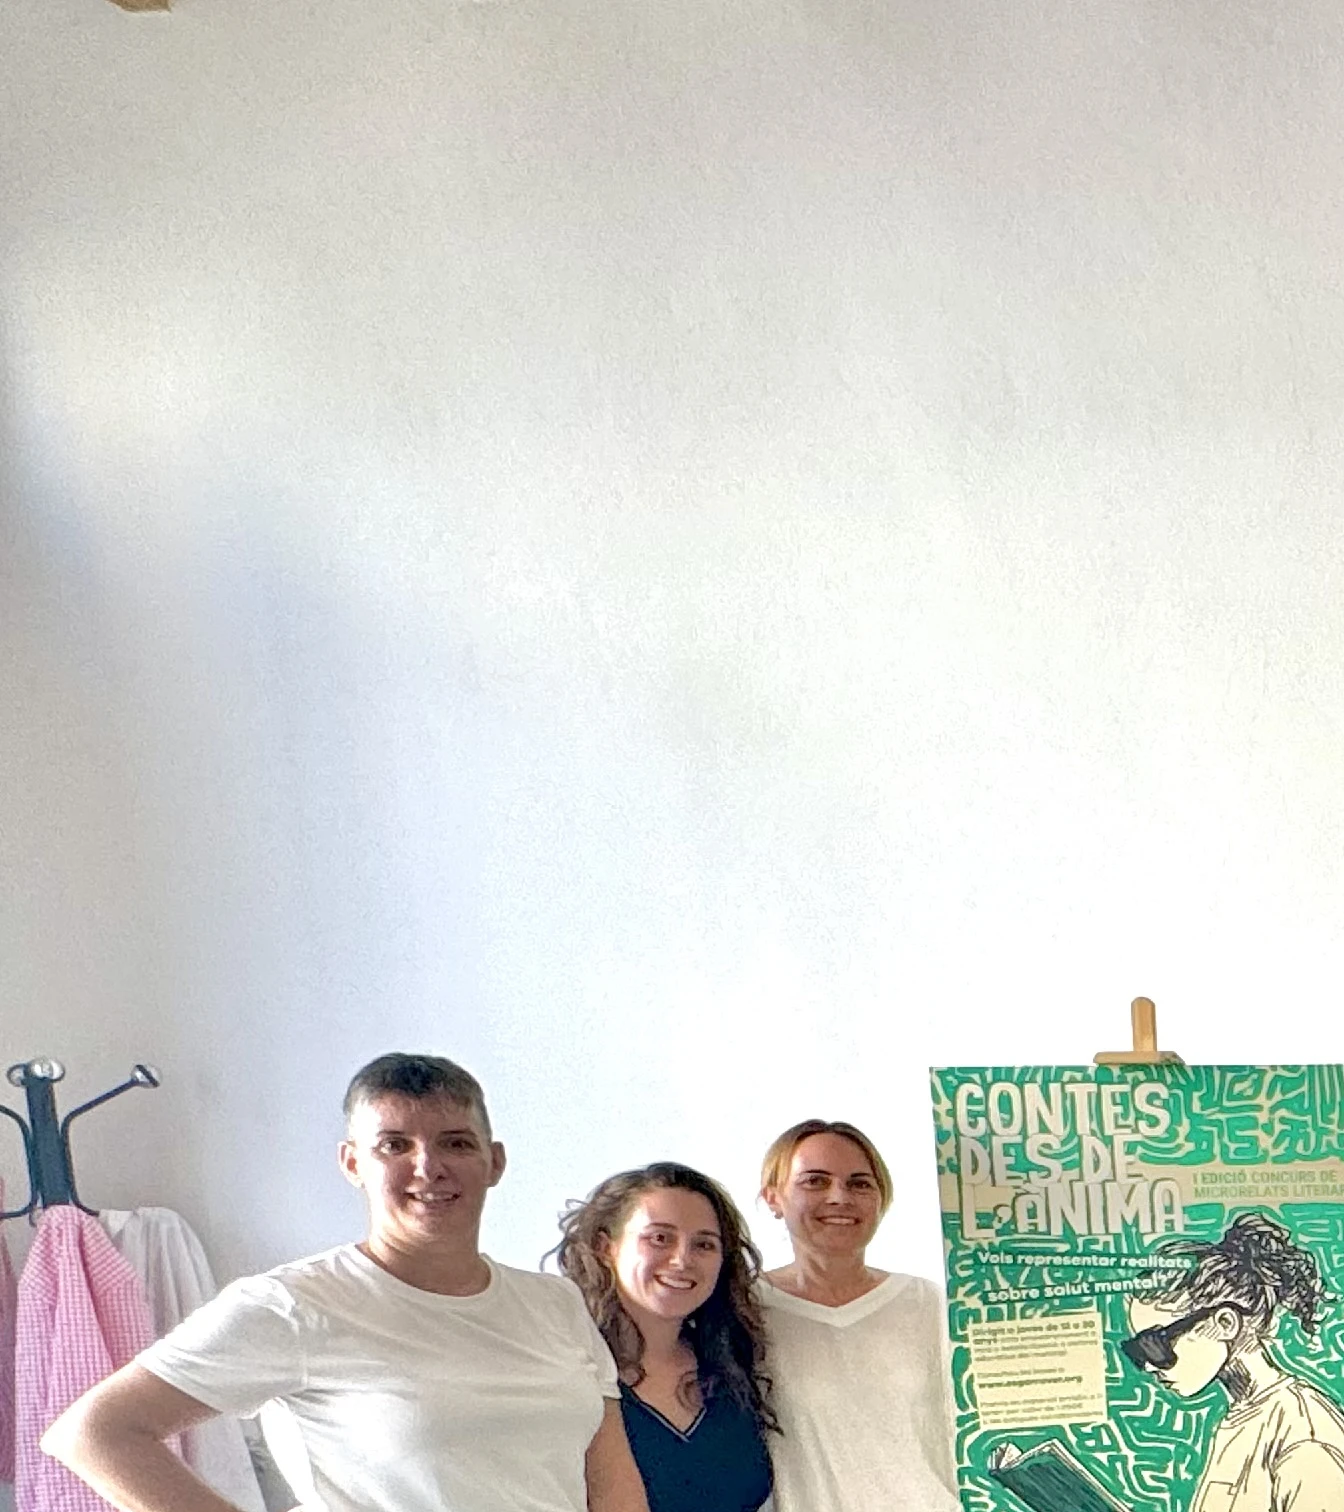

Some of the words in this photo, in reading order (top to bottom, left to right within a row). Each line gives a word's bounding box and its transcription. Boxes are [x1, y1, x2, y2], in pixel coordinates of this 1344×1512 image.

[956, 1082, 1171, 1137] CONTES
[960, 1134, 1063, 1188] DES
[1081, 1134, 1144, 1185] DE
[1203, 1170, 1247, 1184] EDICIÓ
[1251, 1170, 1316, 1183] CONCURS
[1320, 1170, 1338, 1183] DE
[1194, 1184, 1288, 1198] MICRORELATS
[977, 1251, 1014, 1264] Vols
[1016, 1252, 1116, 1267] representar
[1120, 1253, 1192, 1269] realitats
[987, 1286, 1040, 1302] sobre
[1044, 1281, 1090, 1298] salut
[1094, 1273, 1168, 1293] mental?
